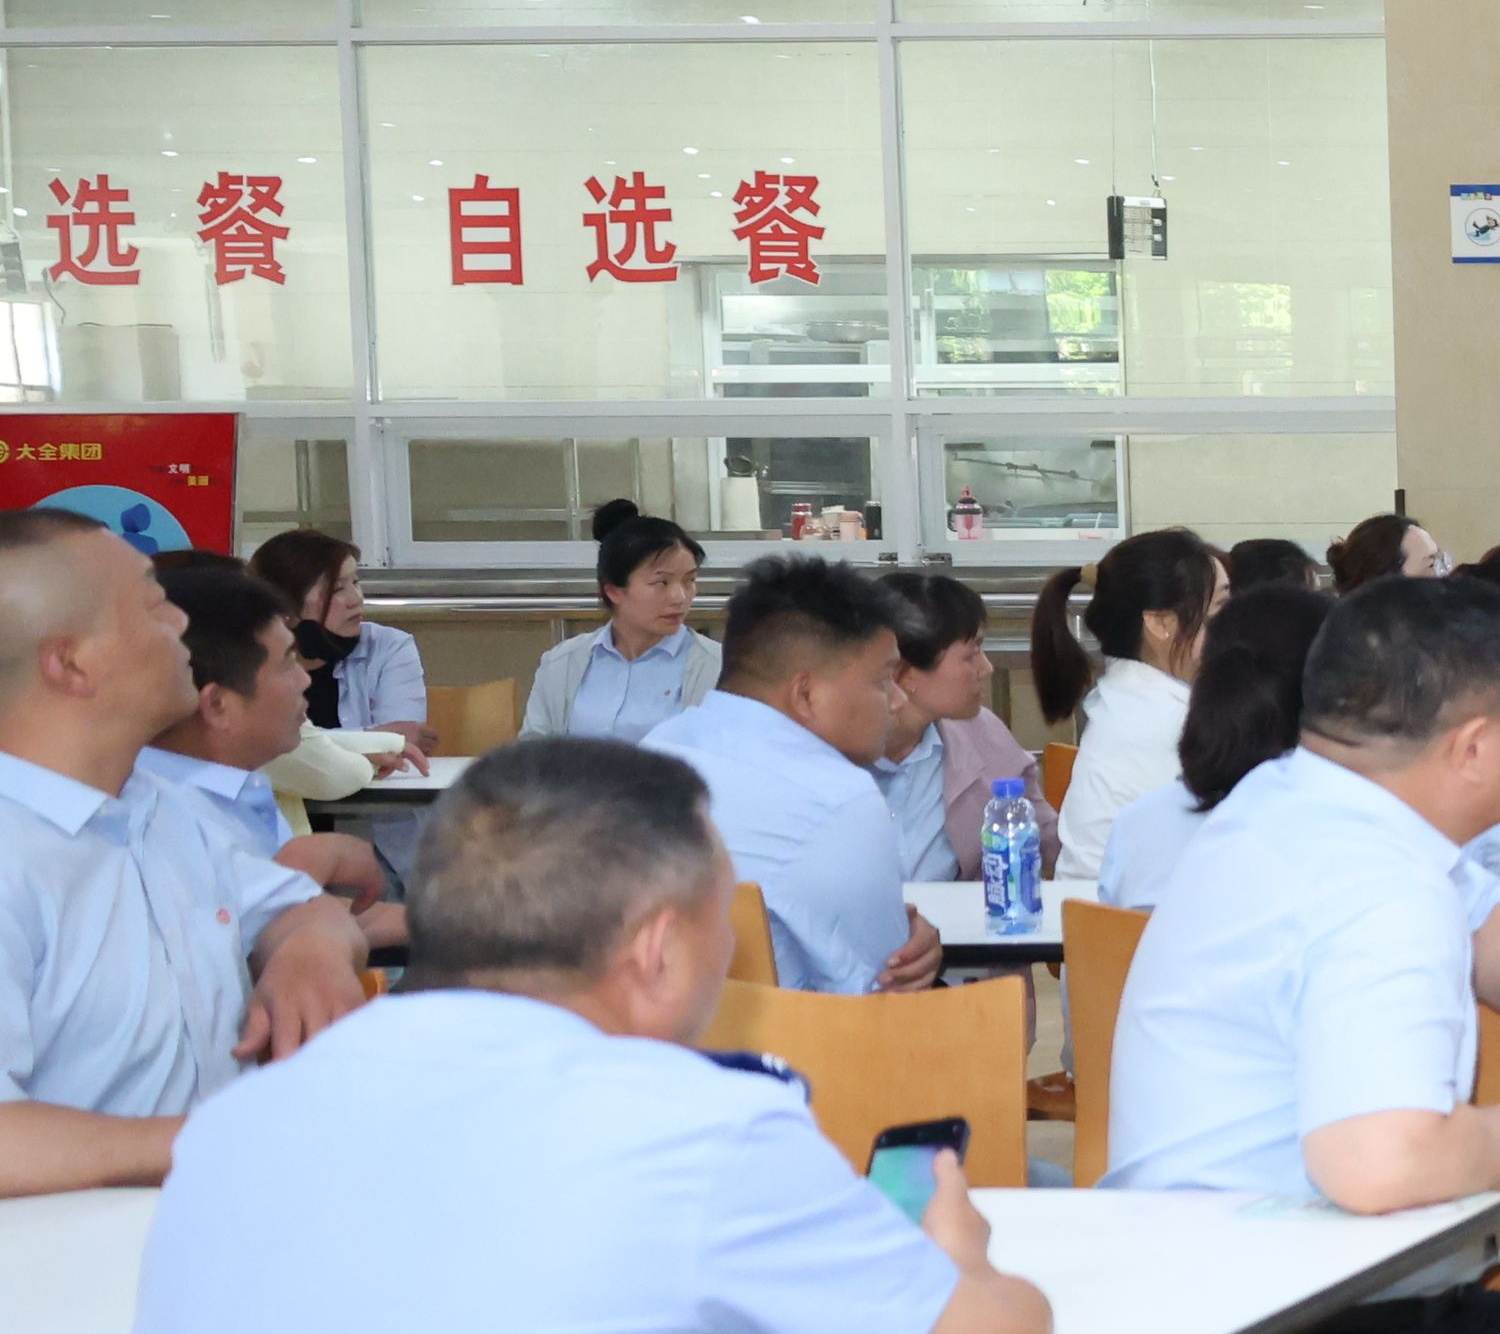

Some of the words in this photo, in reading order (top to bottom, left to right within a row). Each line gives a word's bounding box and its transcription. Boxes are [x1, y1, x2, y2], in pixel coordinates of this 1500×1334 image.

[46, 171, 290, 286] 选餐
[447, 170, 825, 286] 自选餐
[16, 443, 103, 461] 大全集团
